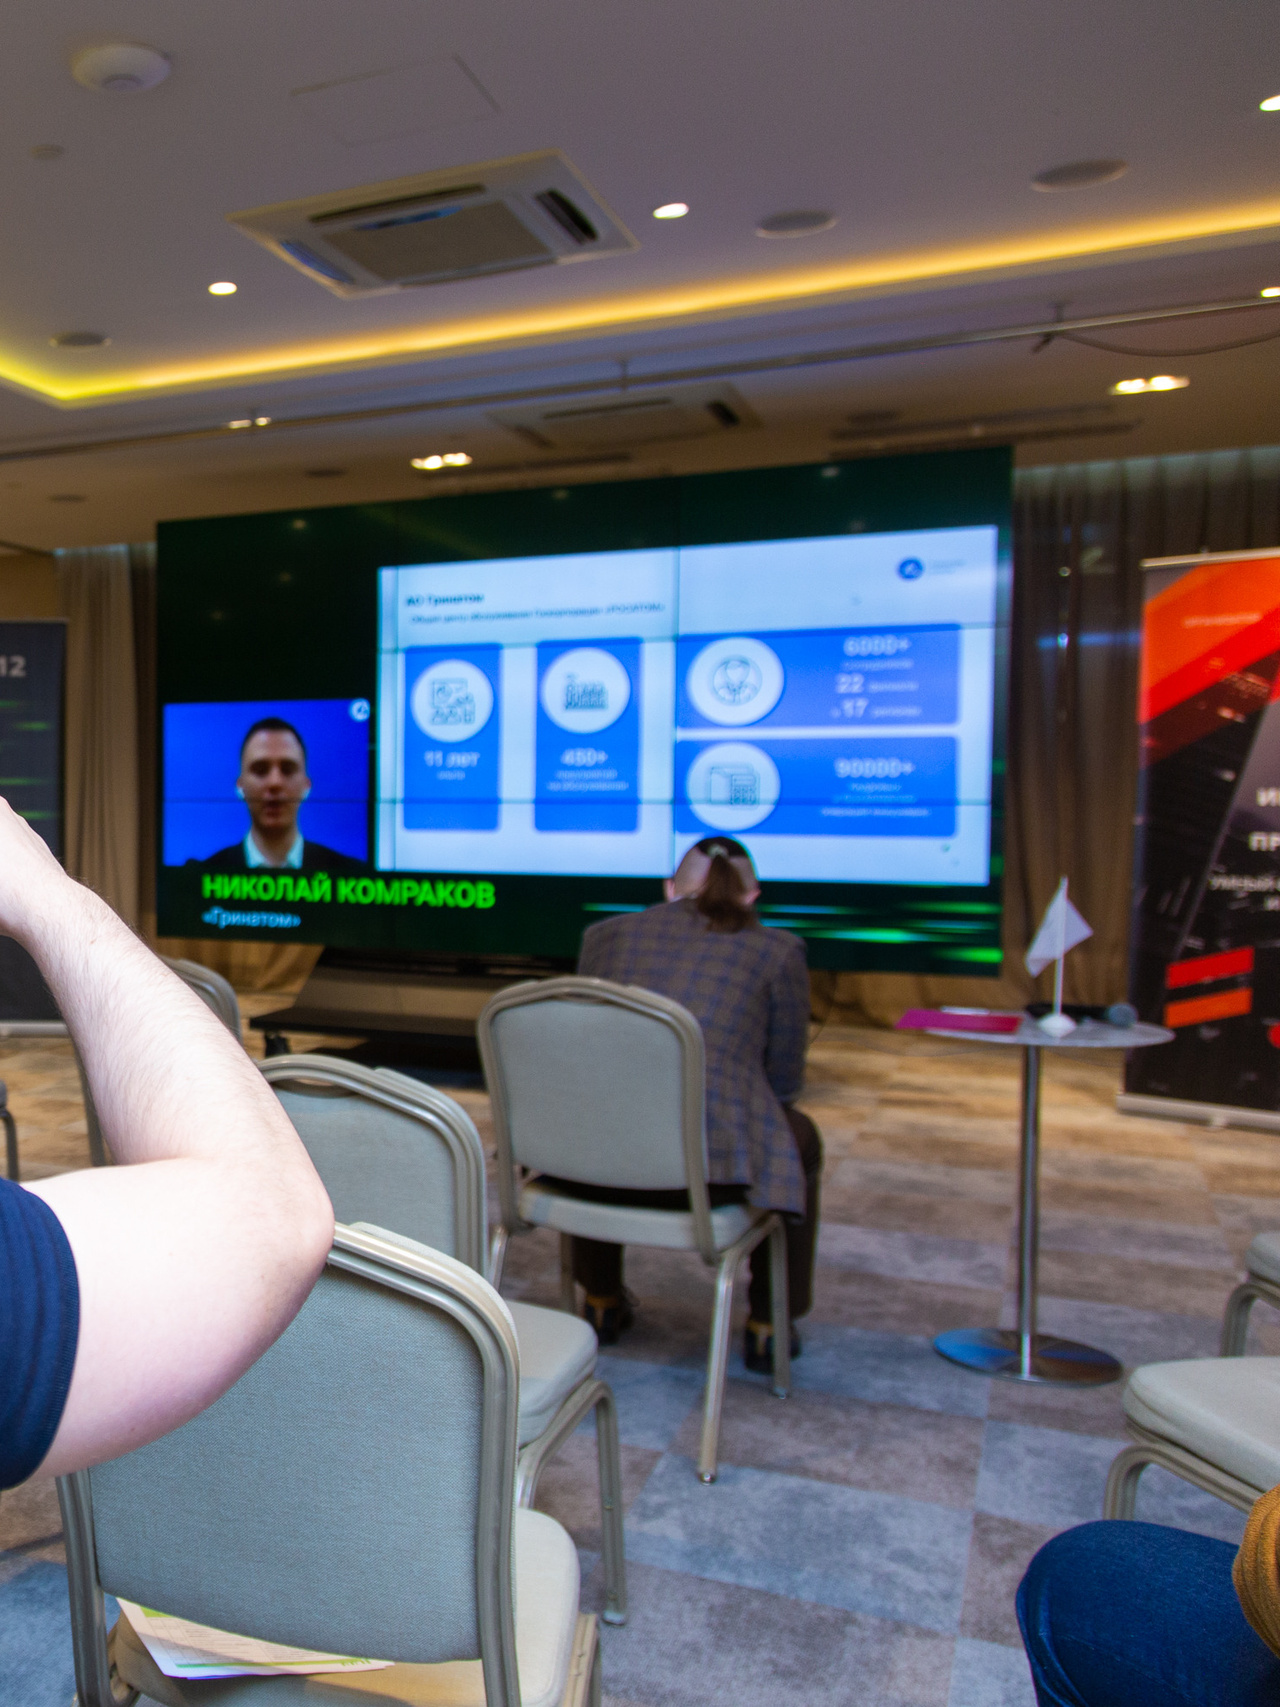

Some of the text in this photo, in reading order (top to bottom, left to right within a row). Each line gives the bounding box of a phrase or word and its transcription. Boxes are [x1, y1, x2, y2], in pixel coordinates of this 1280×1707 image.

[835, 666, 865, 694] 22
[842, 698, 869, 718] 17
[424, 750, 443, 767] 11
[202, 872, 496, 909] НИКОЛАЙ КОМРАКОВ
